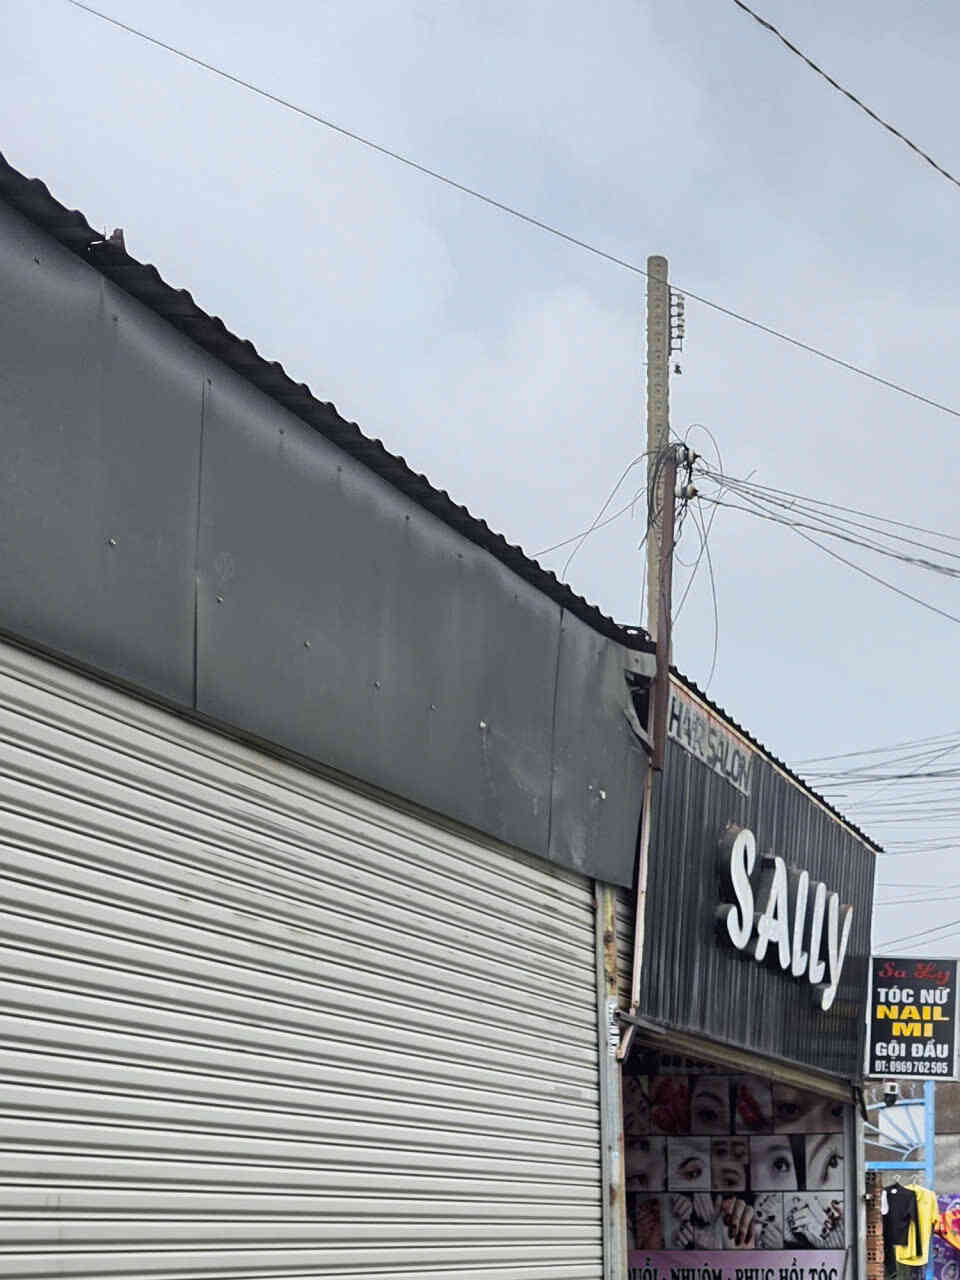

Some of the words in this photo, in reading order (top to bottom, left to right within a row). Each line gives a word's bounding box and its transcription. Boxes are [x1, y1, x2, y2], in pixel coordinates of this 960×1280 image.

[877, 985, 914, 1003] TÓC
[920, 986, 950, 1004] NỮ
[876, 1004, 950, 1021] NAIL
[891, 1022, 933, 1038] MI
[875, 1039, 906, 1059] GỘI
[912, 1061, 931, 1074] 762
[931, 1062, 948, 1074] 505
